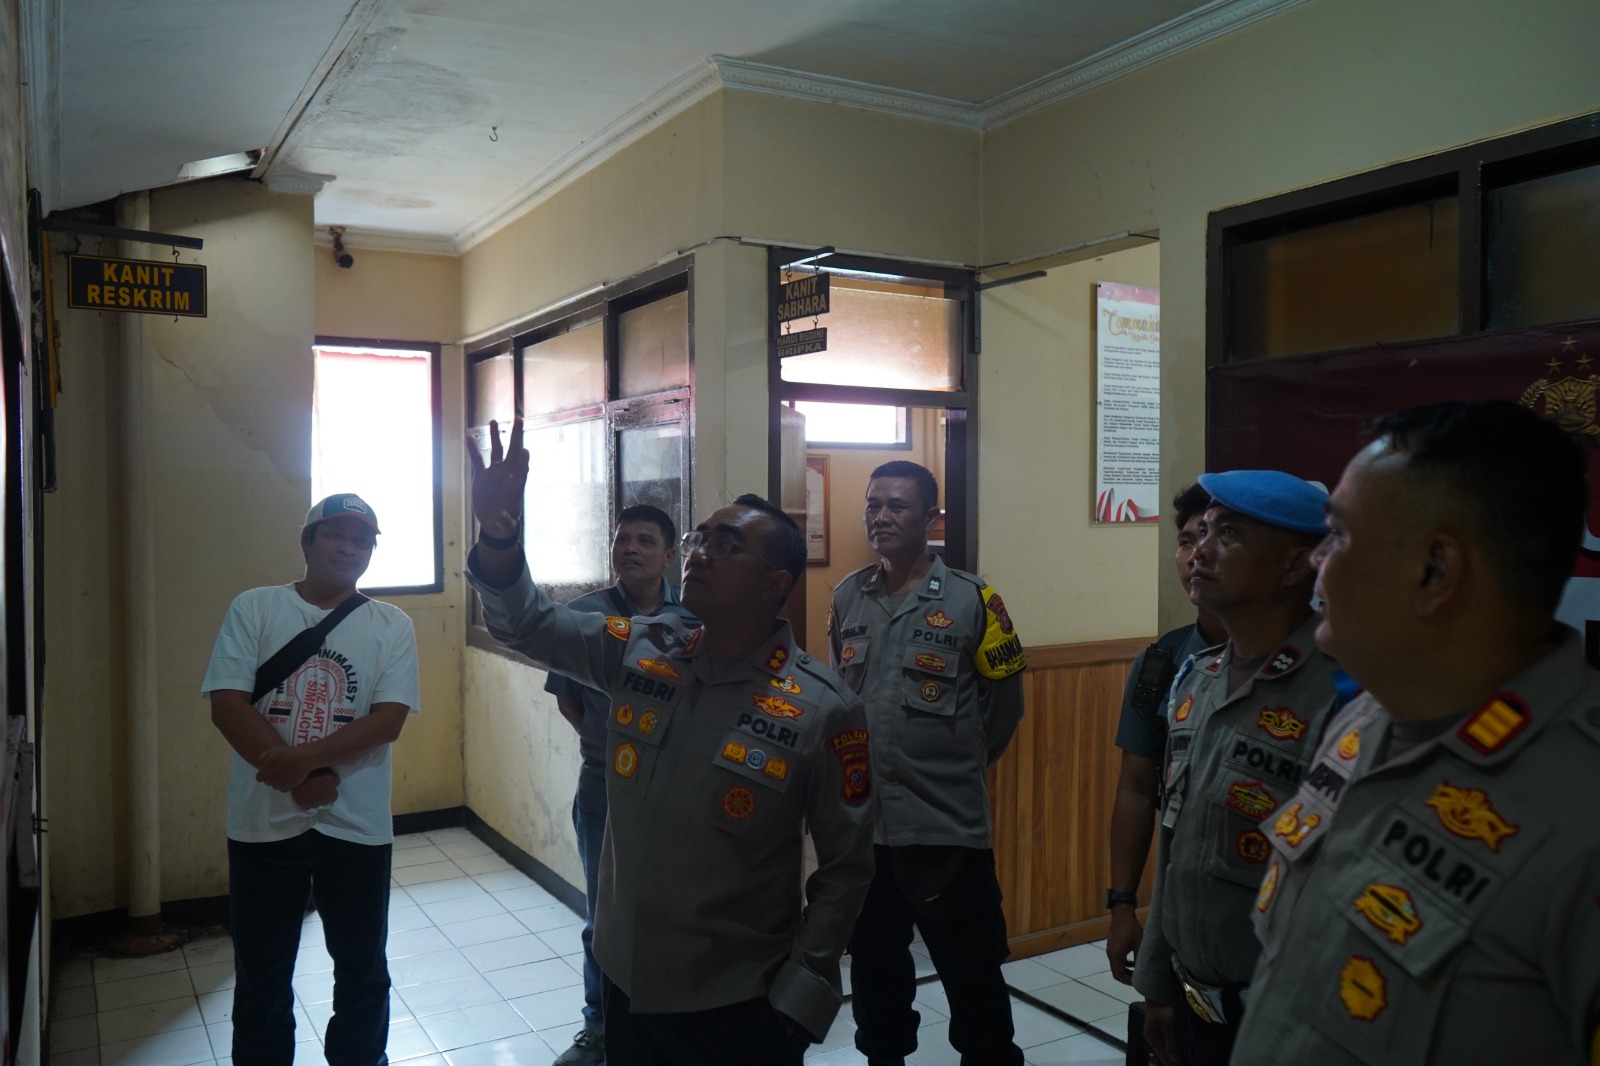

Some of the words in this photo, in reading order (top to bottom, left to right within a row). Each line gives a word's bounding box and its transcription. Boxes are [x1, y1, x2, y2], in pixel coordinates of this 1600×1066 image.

[103, 262, 175, 287] KANIT
[87, 284, 190, 311] RESKRIM
[785, 277, 818, 300] KANIT
[777, 293, 827, 320] SABHARA
[776, 334, 798, 346] HARDI
[777, 342, 823, 357] BRIPKA
[912, 628, 958, 647] POLRI
[622, 670, 677, 702] FEBRI
[297, 680, 317, 746] SIMPLICIT
[312, 707, 325, 733] ART
[736, 712, 800, 748] POLRI
[1231, 740, 1303, 784] POLRI
[1381, 818, 1491, 906] POLRI
